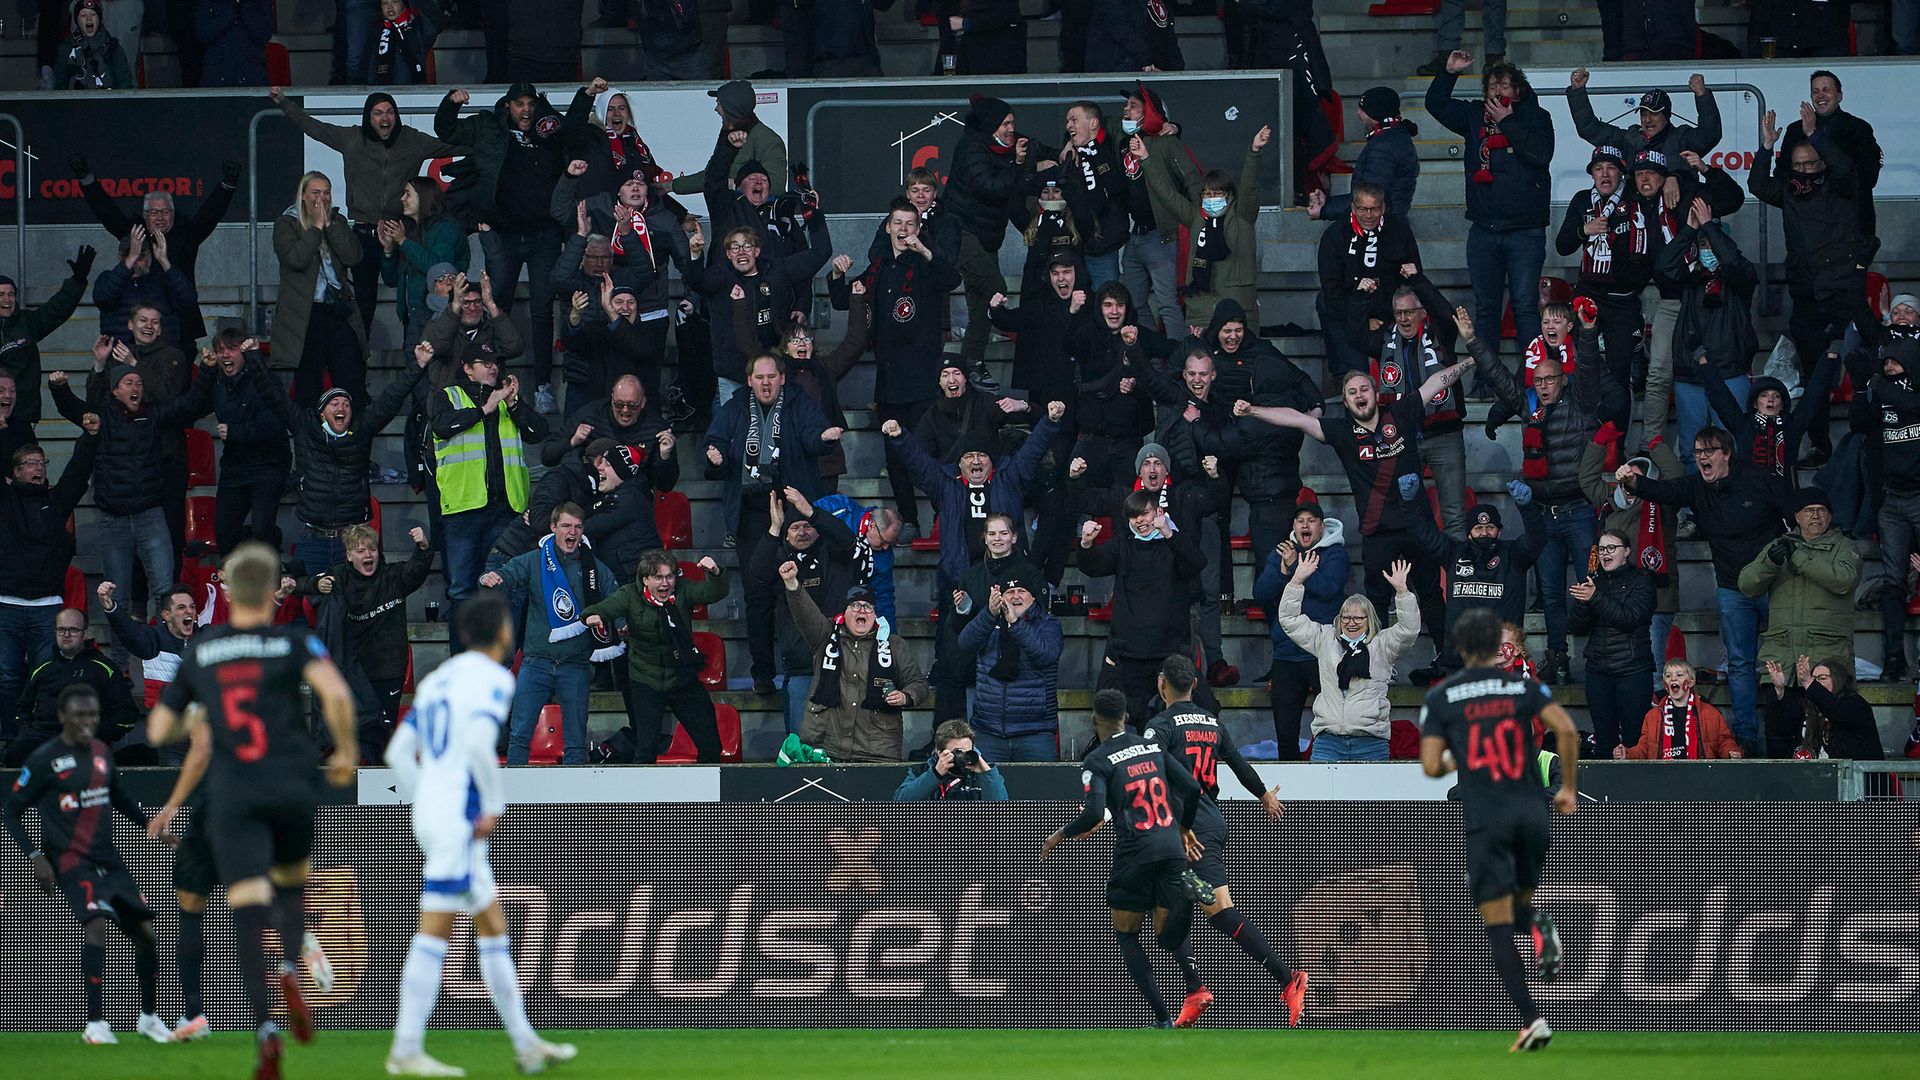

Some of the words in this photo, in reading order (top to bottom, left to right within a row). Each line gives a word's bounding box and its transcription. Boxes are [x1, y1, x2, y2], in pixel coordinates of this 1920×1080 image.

[40, 178, 192, 199] CONRACTOR
[1461, 584, 1487, 596] FAGLIGE
[1488, 585, 1502, 597] HUS
[221, 687, 269, 763] 5
[1466, 717, 1525, 782] 40
[1185, 746, 1216, 795] 74
[1125, 776, 1174, 831] 38
